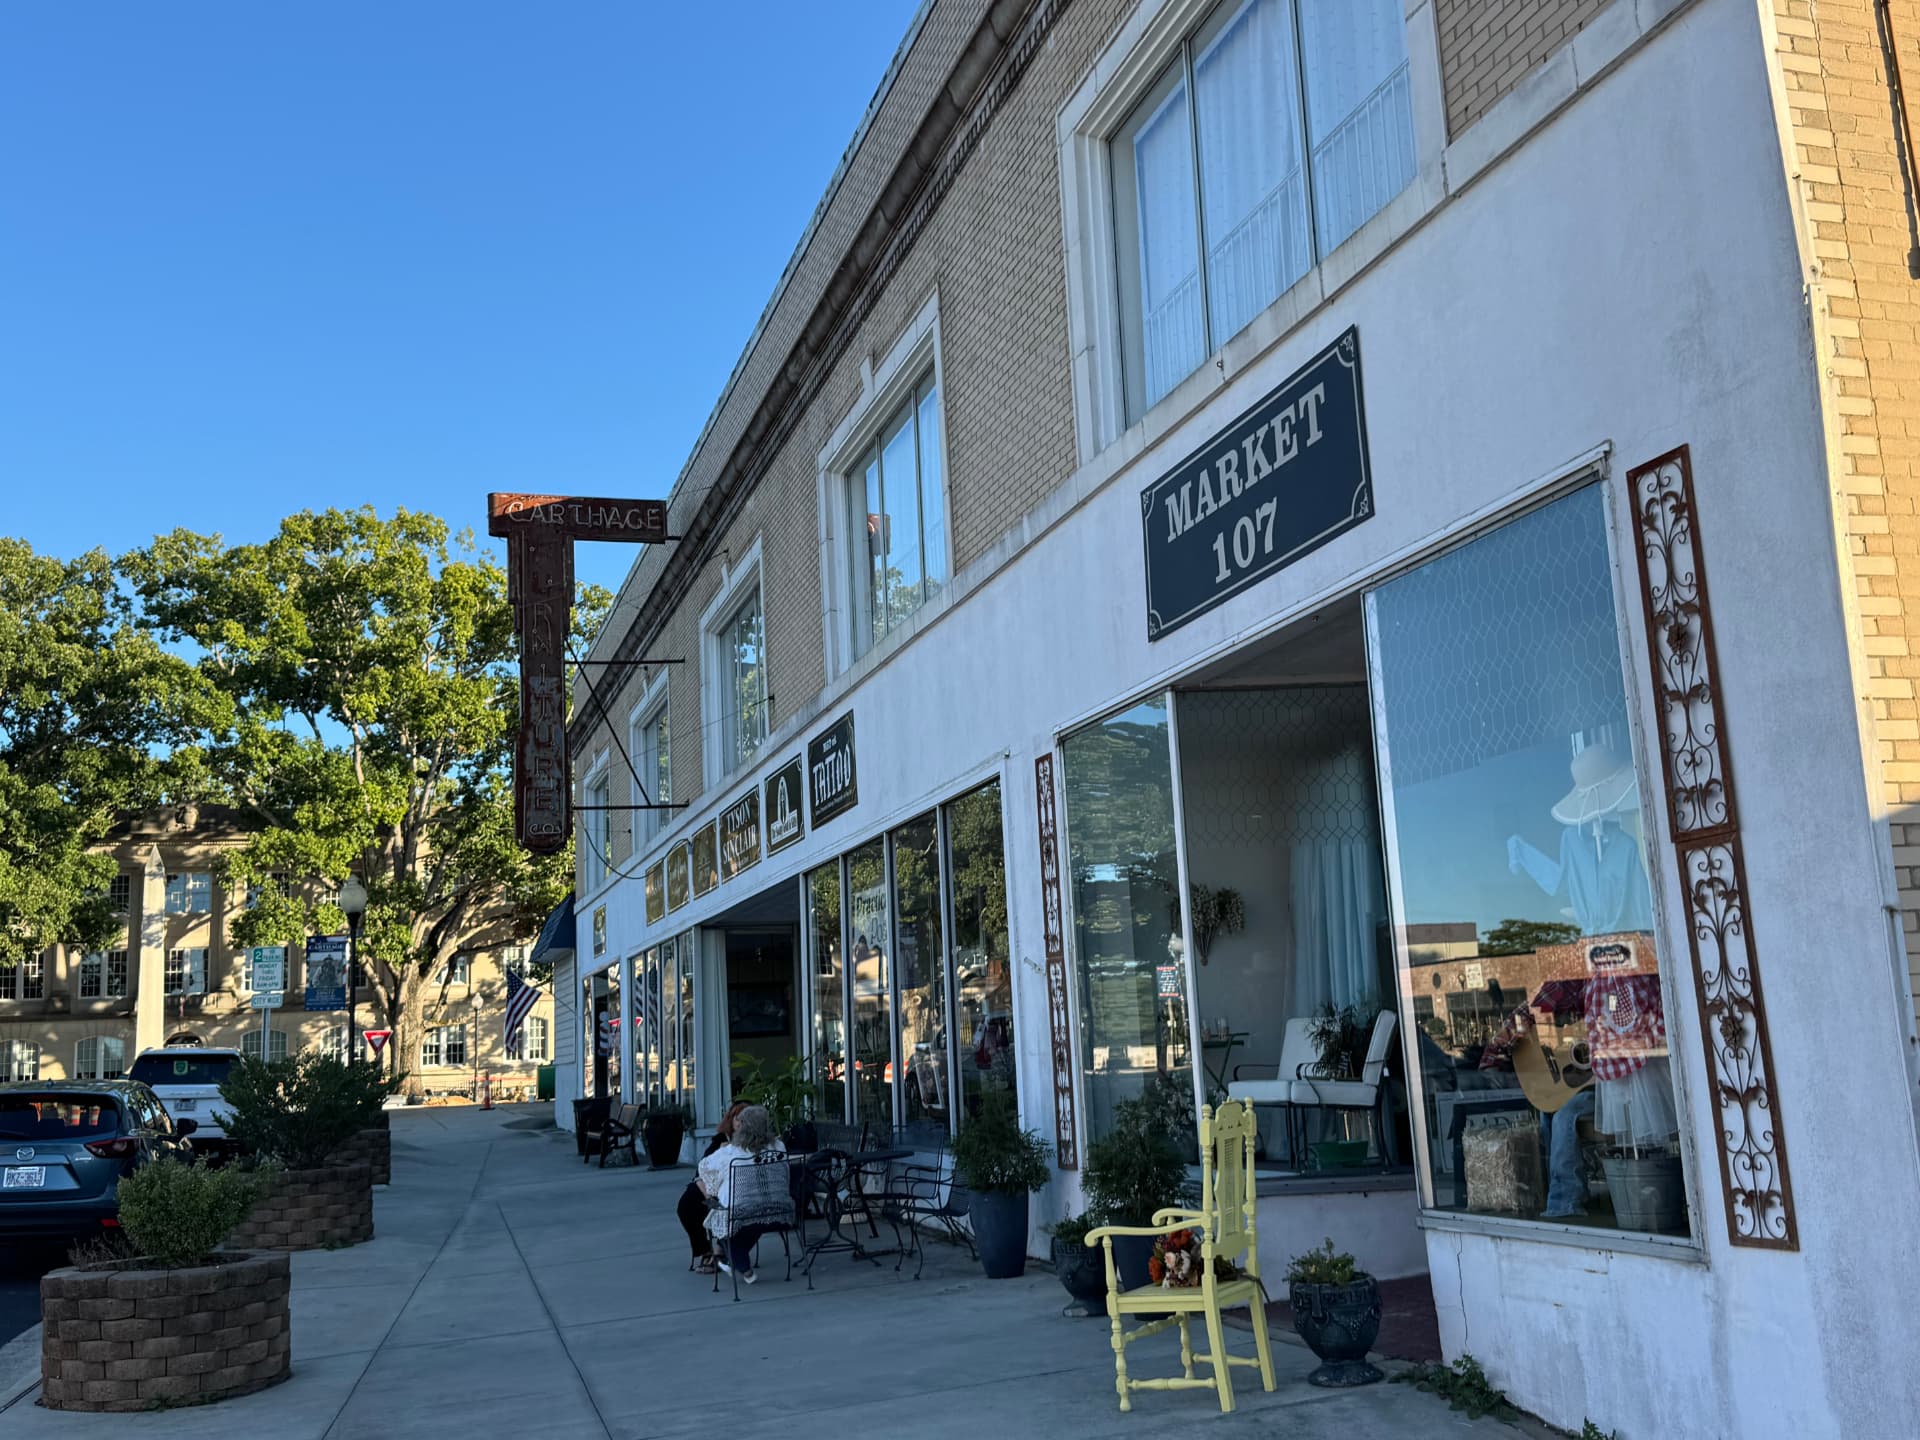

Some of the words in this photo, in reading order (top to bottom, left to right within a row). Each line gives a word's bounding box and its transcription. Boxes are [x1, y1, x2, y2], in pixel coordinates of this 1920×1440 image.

[1165, 382, 1326, 544] MARKET
[508, 501, 662, 530] CARTHAGE
[1212, 496, 1278, 584] 107
[812, 743, 852, 807] TATTOO
[726, 798, 751, 835] TYSON
[722, 823, 757, 865] SINCLAIR
[856, 888, 887, 917] Practic
[255, 951, 262, 960] 2
[253, 996, 266, 1005] CITY
